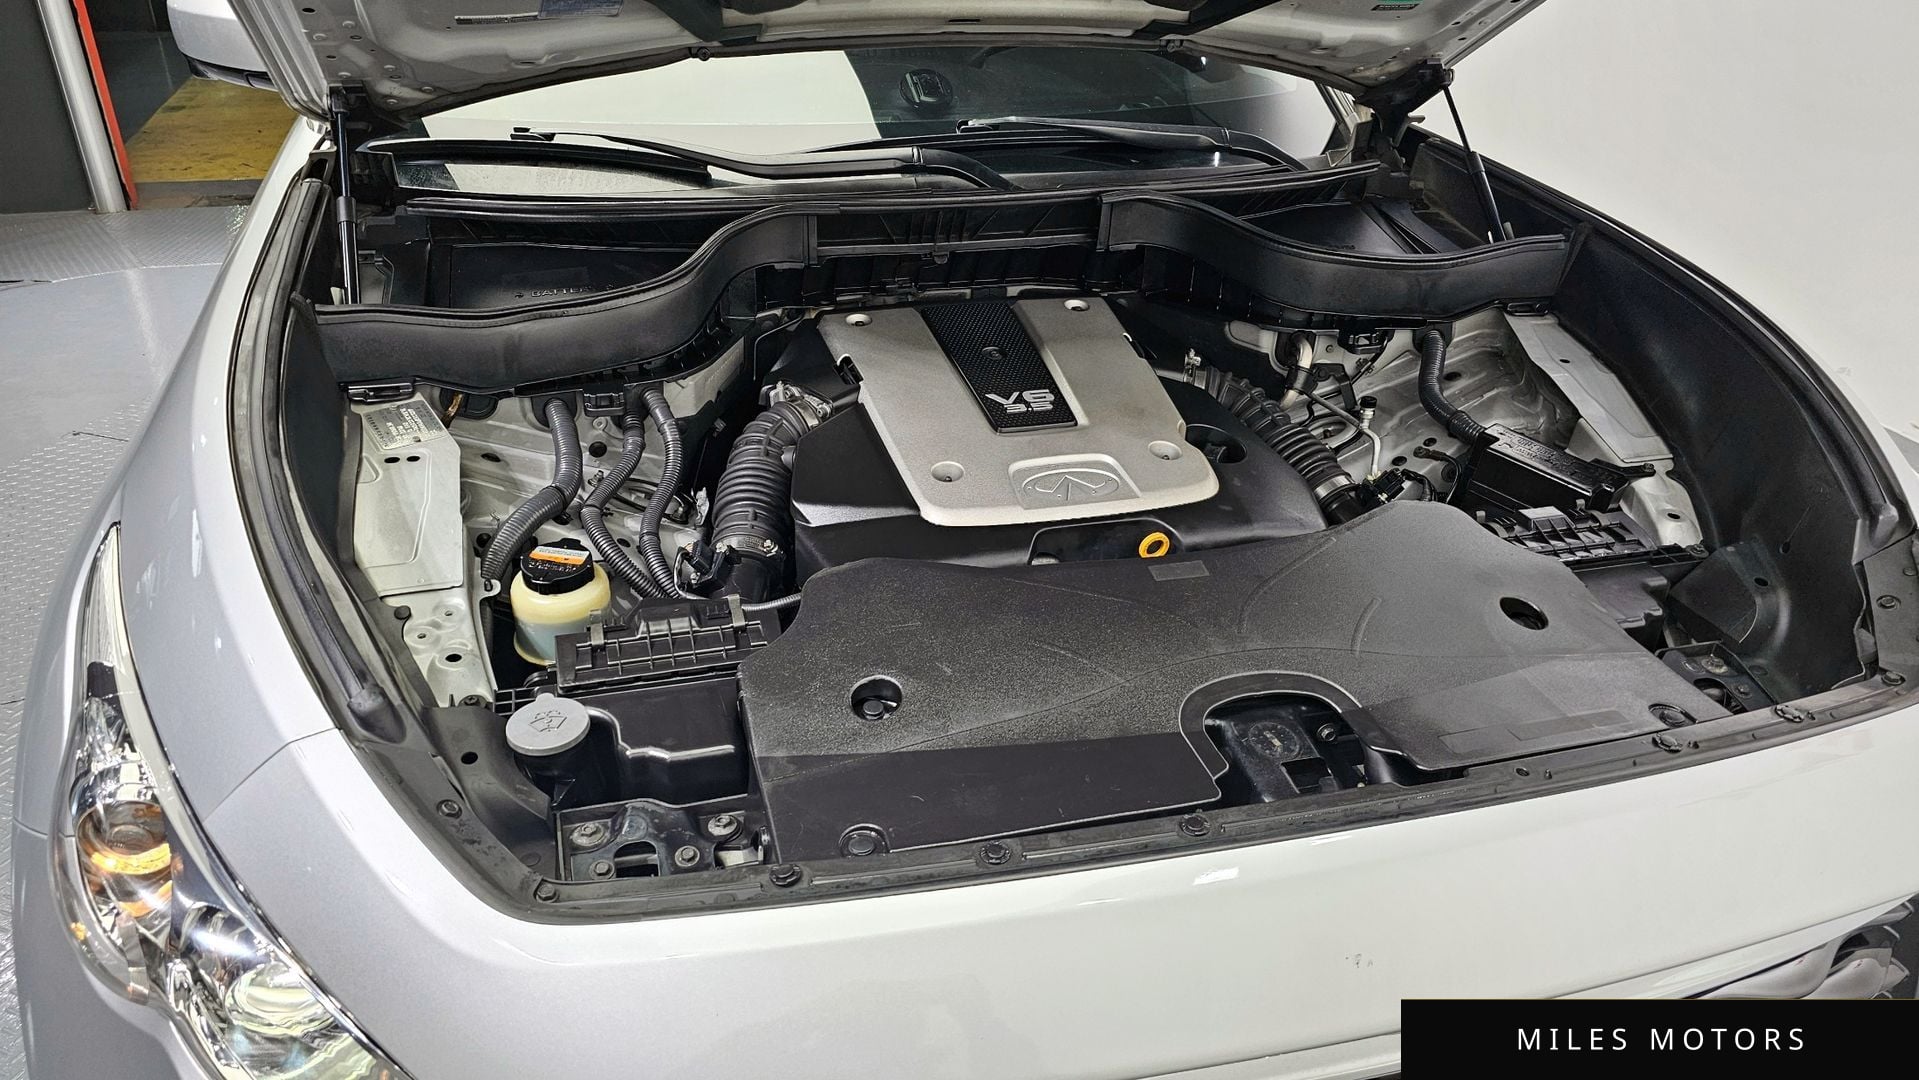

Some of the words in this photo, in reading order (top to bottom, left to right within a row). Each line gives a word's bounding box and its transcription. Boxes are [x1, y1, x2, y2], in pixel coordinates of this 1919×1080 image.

[531, 286, 594, 297] BATTER
[985, 389, 1055, 405] V6
[1004, 401, 1053, 414] 3.5
